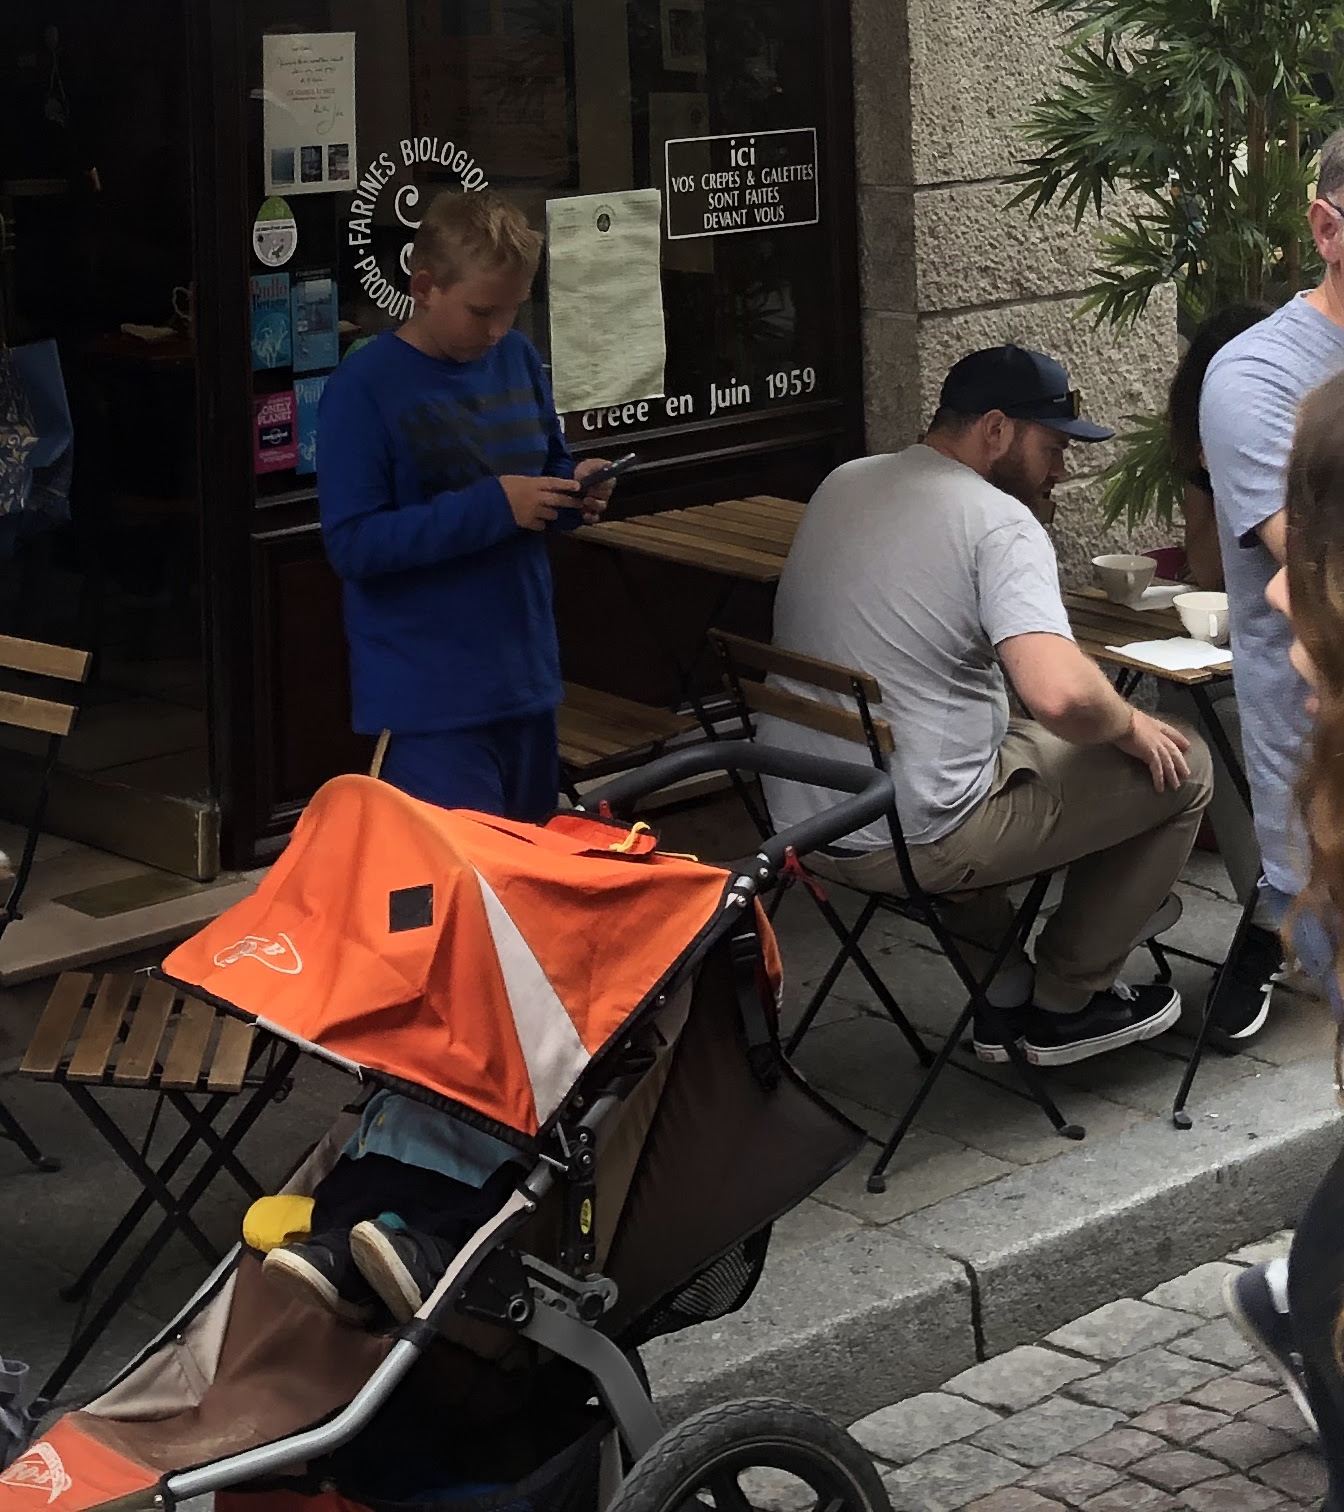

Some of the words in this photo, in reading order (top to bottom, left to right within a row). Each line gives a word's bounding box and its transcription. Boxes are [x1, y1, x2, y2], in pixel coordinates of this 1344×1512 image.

[730, 137, 756, 167] ici
[672, 175, 695, 193] VOS
[701, 170, 741, 190] CREPES
[746, 170, 756, 186] &
[761, 163, 814, 185] GALETTES
[349, 152, 396, 245] FARINES
[708, 190, 740, 210] SONT
[745, 186, 780, 206] FAITES
[703, 208, 748, 229] DEVANT
[754, 204, 785, 223] VOUS
[665, 393, 694, 417] en
[709, 377, 751, 416] Juin
[765, 367, 817, 399] 1959
